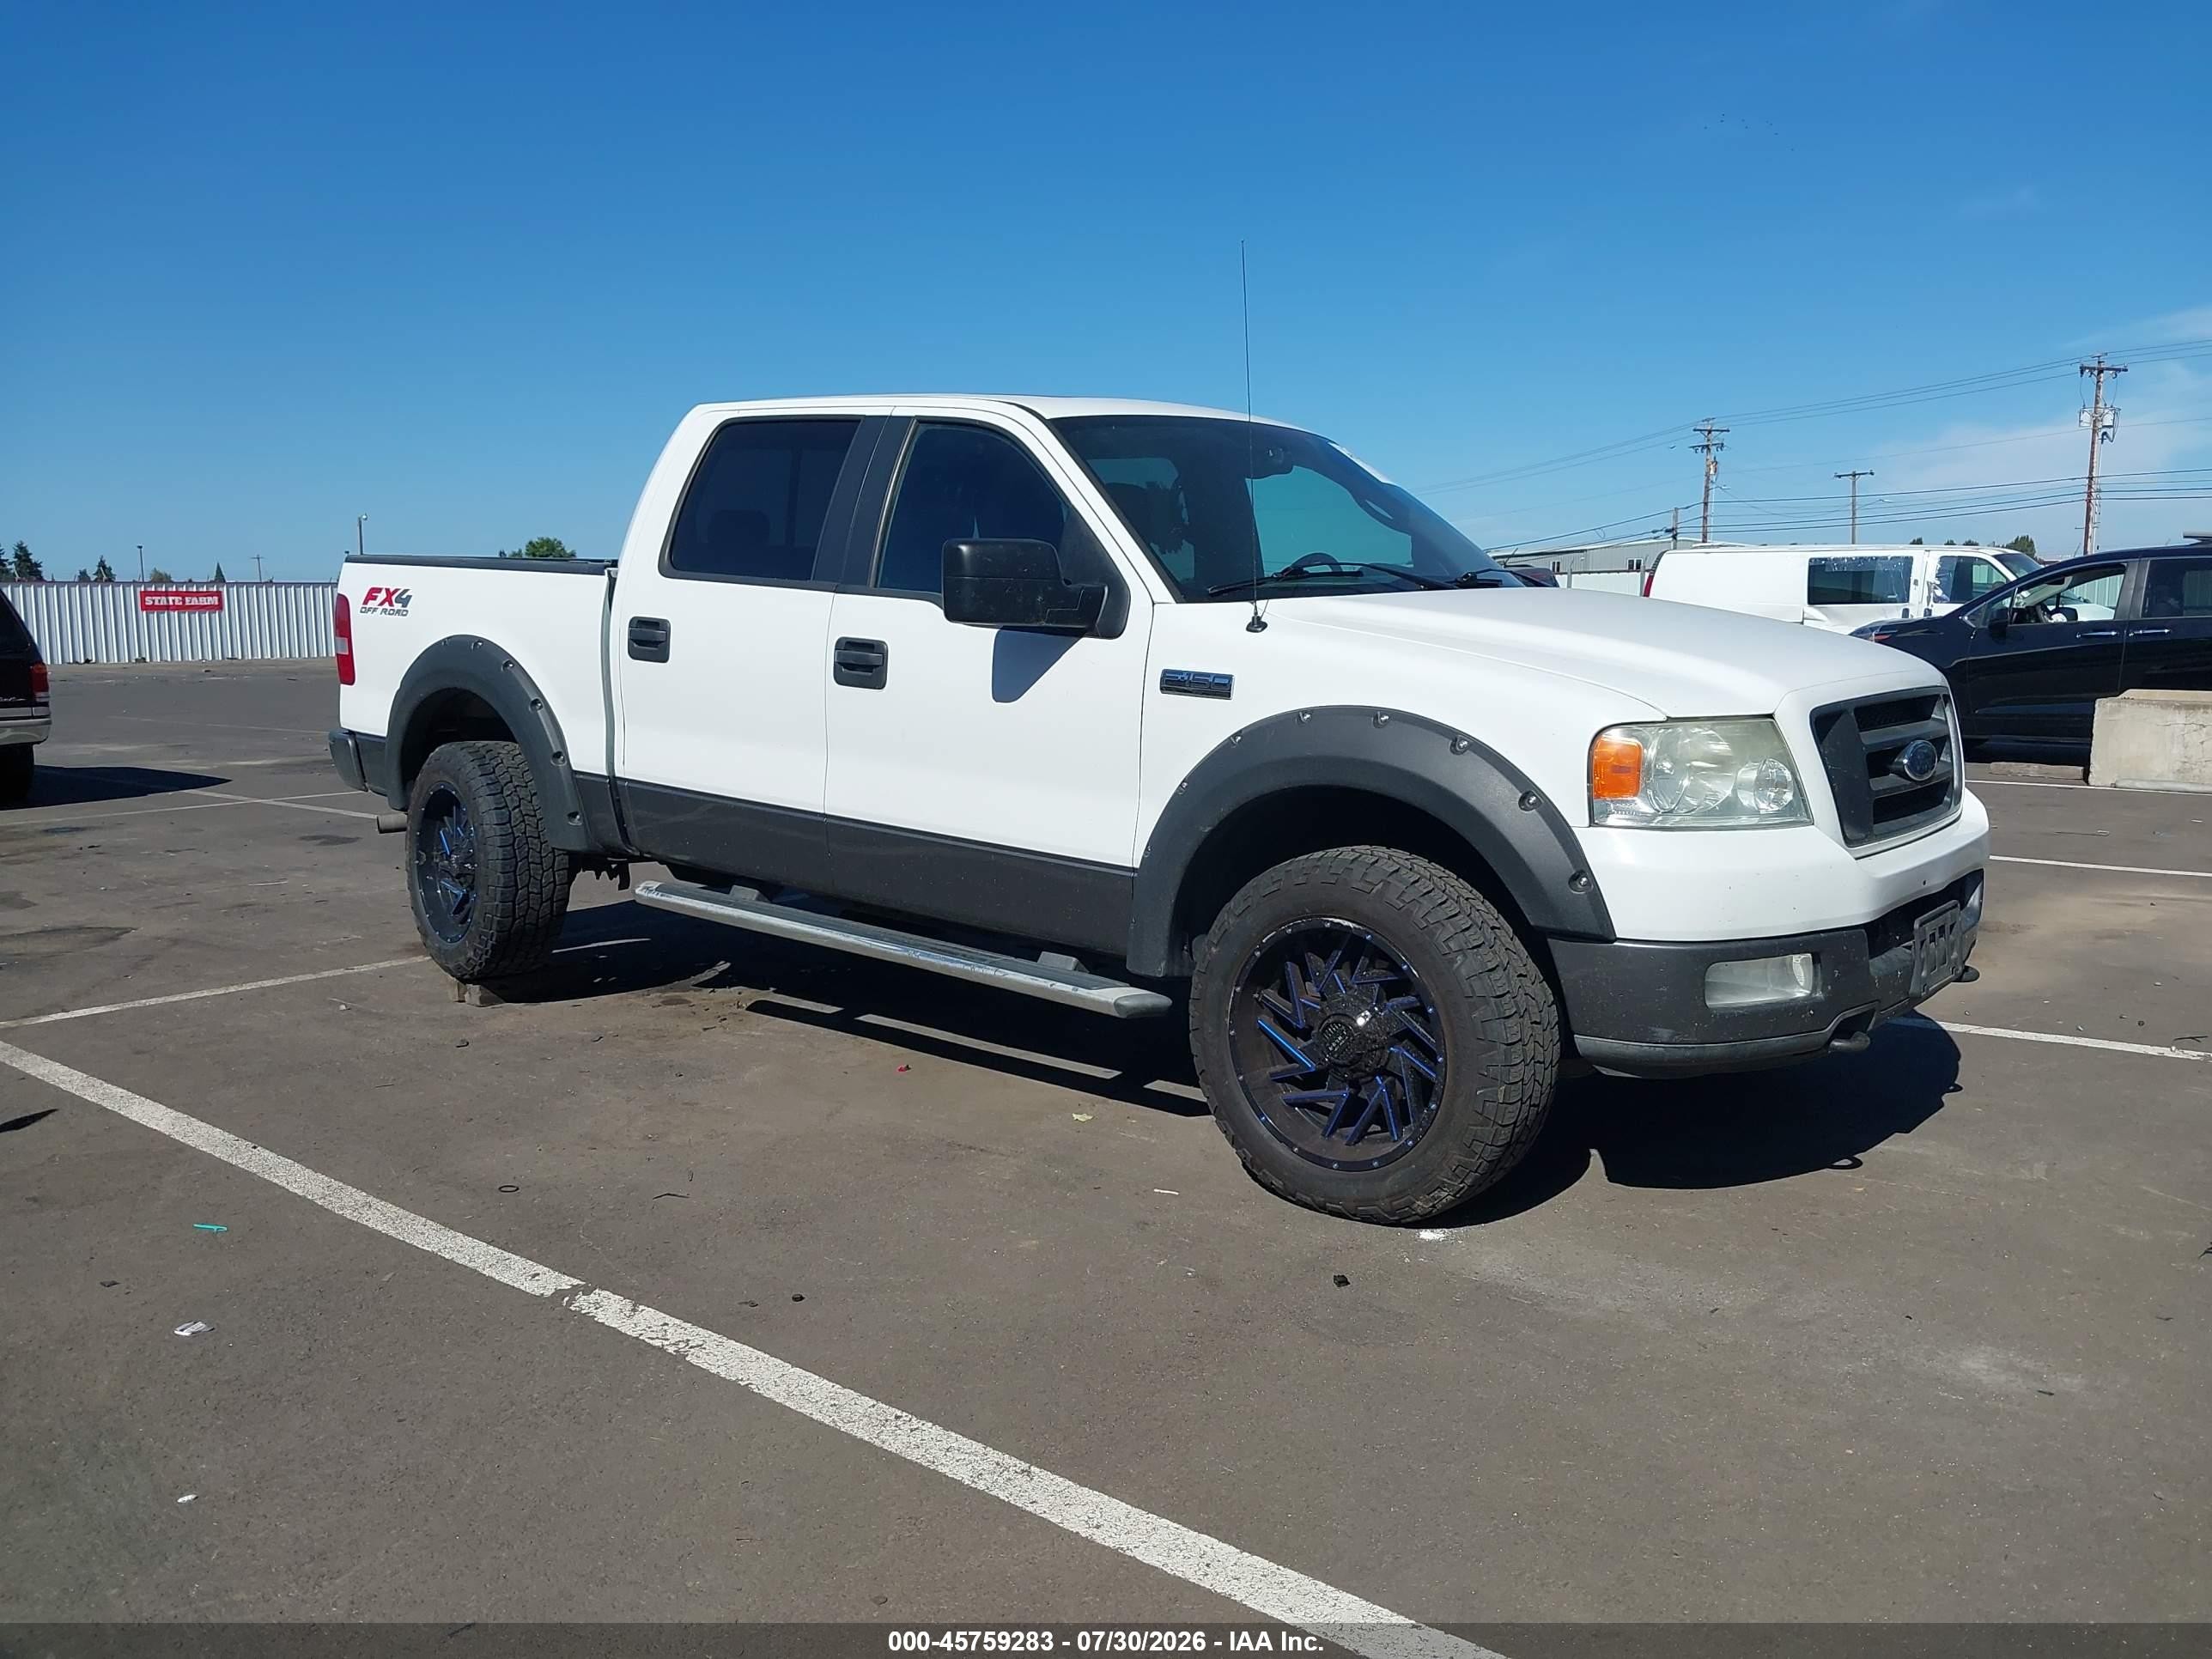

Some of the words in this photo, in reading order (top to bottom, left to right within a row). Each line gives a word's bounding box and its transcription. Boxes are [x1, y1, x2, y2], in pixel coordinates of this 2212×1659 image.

[144, 596, 183, 605] STATE
[362, 586, 412, 608] FX4
[360, 606, 379, 615] OFF
[380, 608, 410, 617] ROAD
